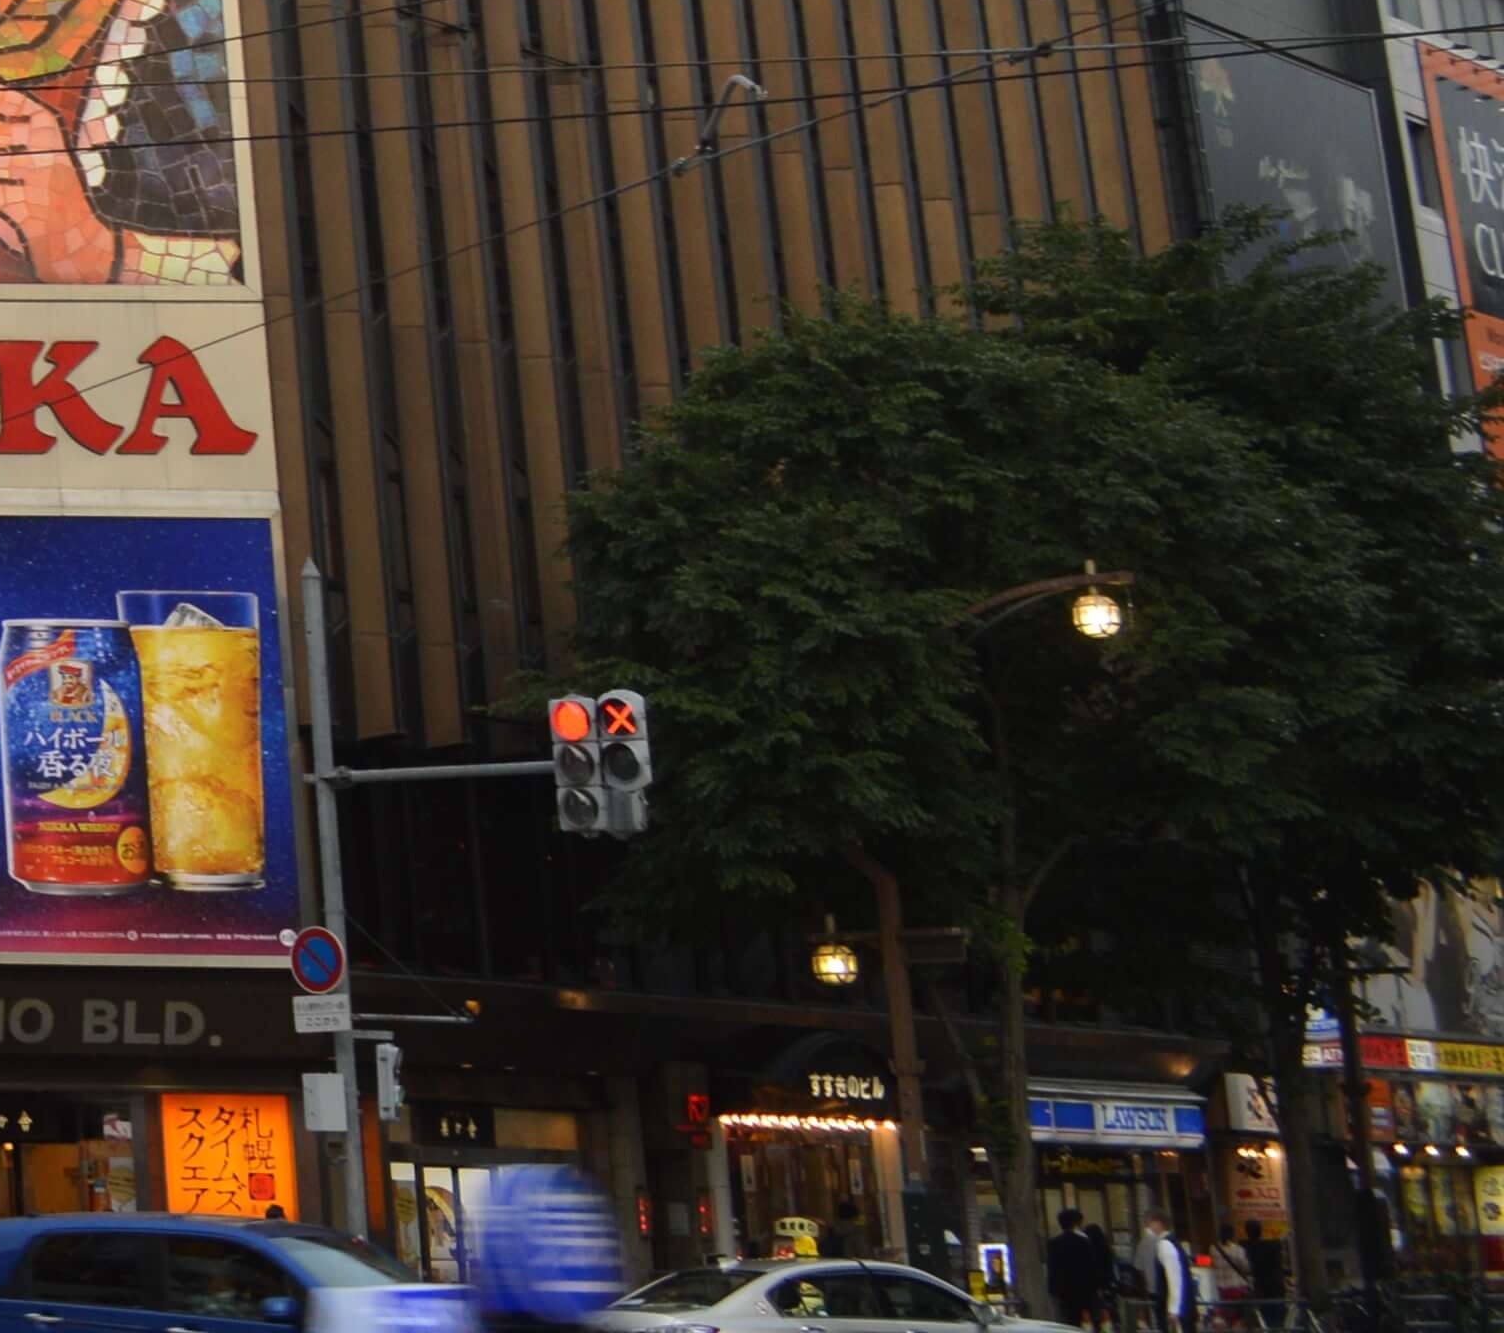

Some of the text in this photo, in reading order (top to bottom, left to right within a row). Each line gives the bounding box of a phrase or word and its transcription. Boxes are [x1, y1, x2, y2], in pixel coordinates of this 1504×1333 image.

[24, 728, 127, 749] ハイボール
[37, 751, 115, 778] 香る夜
[82, 999, 224, 1047] BLD.
[809, 1074, 885, 1101] すすきのビル
[1100, 1103, 1168, 1132] LAWSON
[240, 1107, 277, 1171] 札幌
[177, 1107, 208, 1214] スクエア
[210, 1106, 246, 1212] タイムズ
